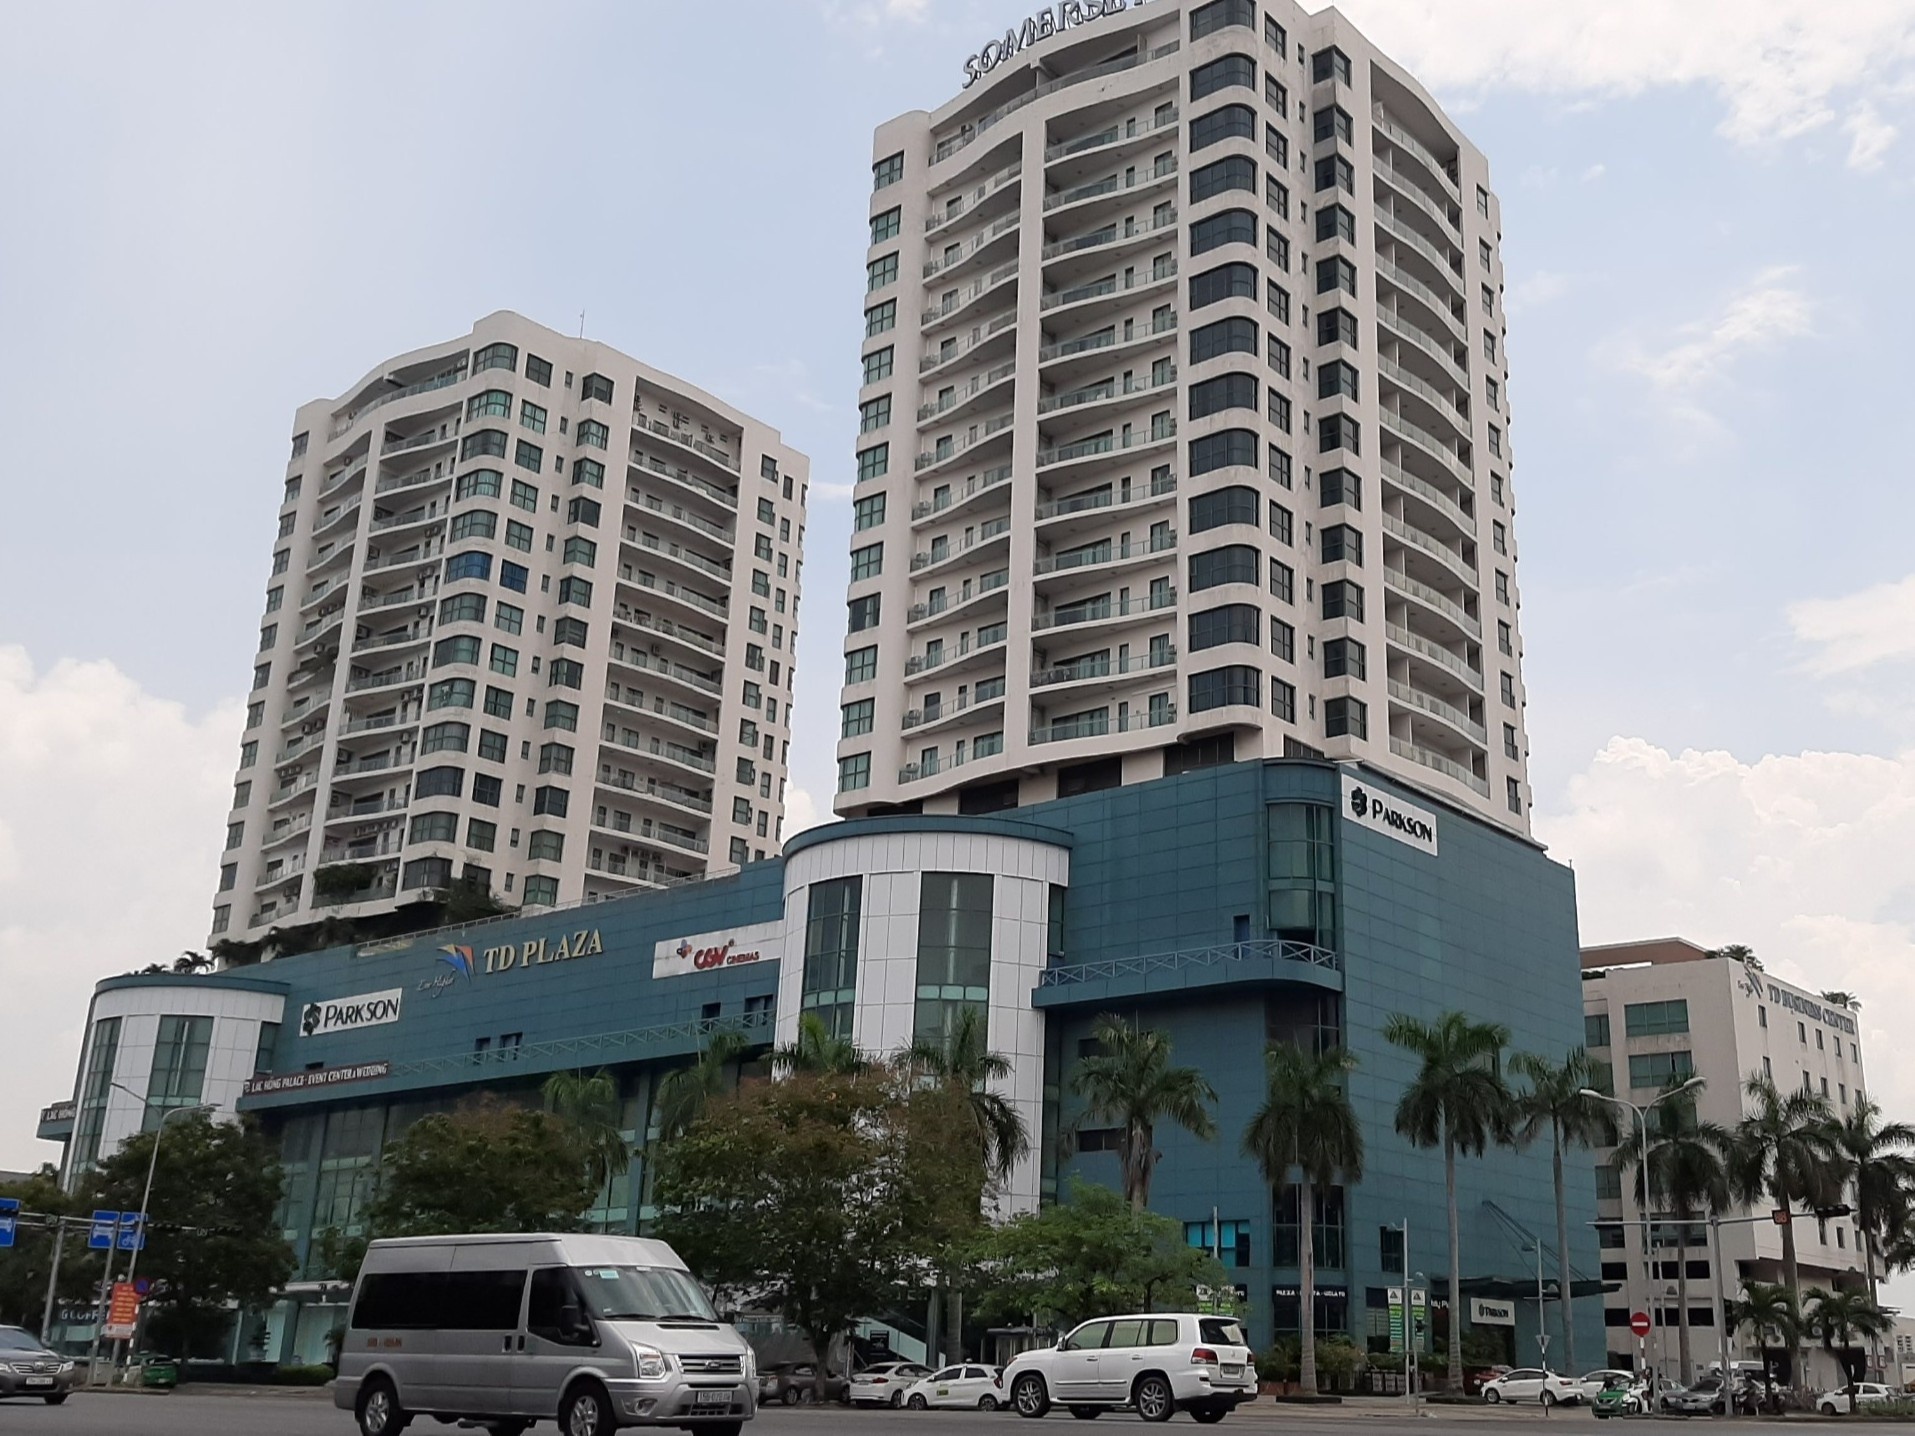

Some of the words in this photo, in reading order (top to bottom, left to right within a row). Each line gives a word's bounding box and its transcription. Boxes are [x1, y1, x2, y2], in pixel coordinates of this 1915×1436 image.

[1371, 798, 1433, 843] PARKSON
[483, 944, 516, 974] TD
[520, 928, 603, 968] PLAZA
[694, 945, 730, 970] CGV
[323, 997, 399, 1028] PARKSON
[1822, 1008, 1855, 1035] CENTER
